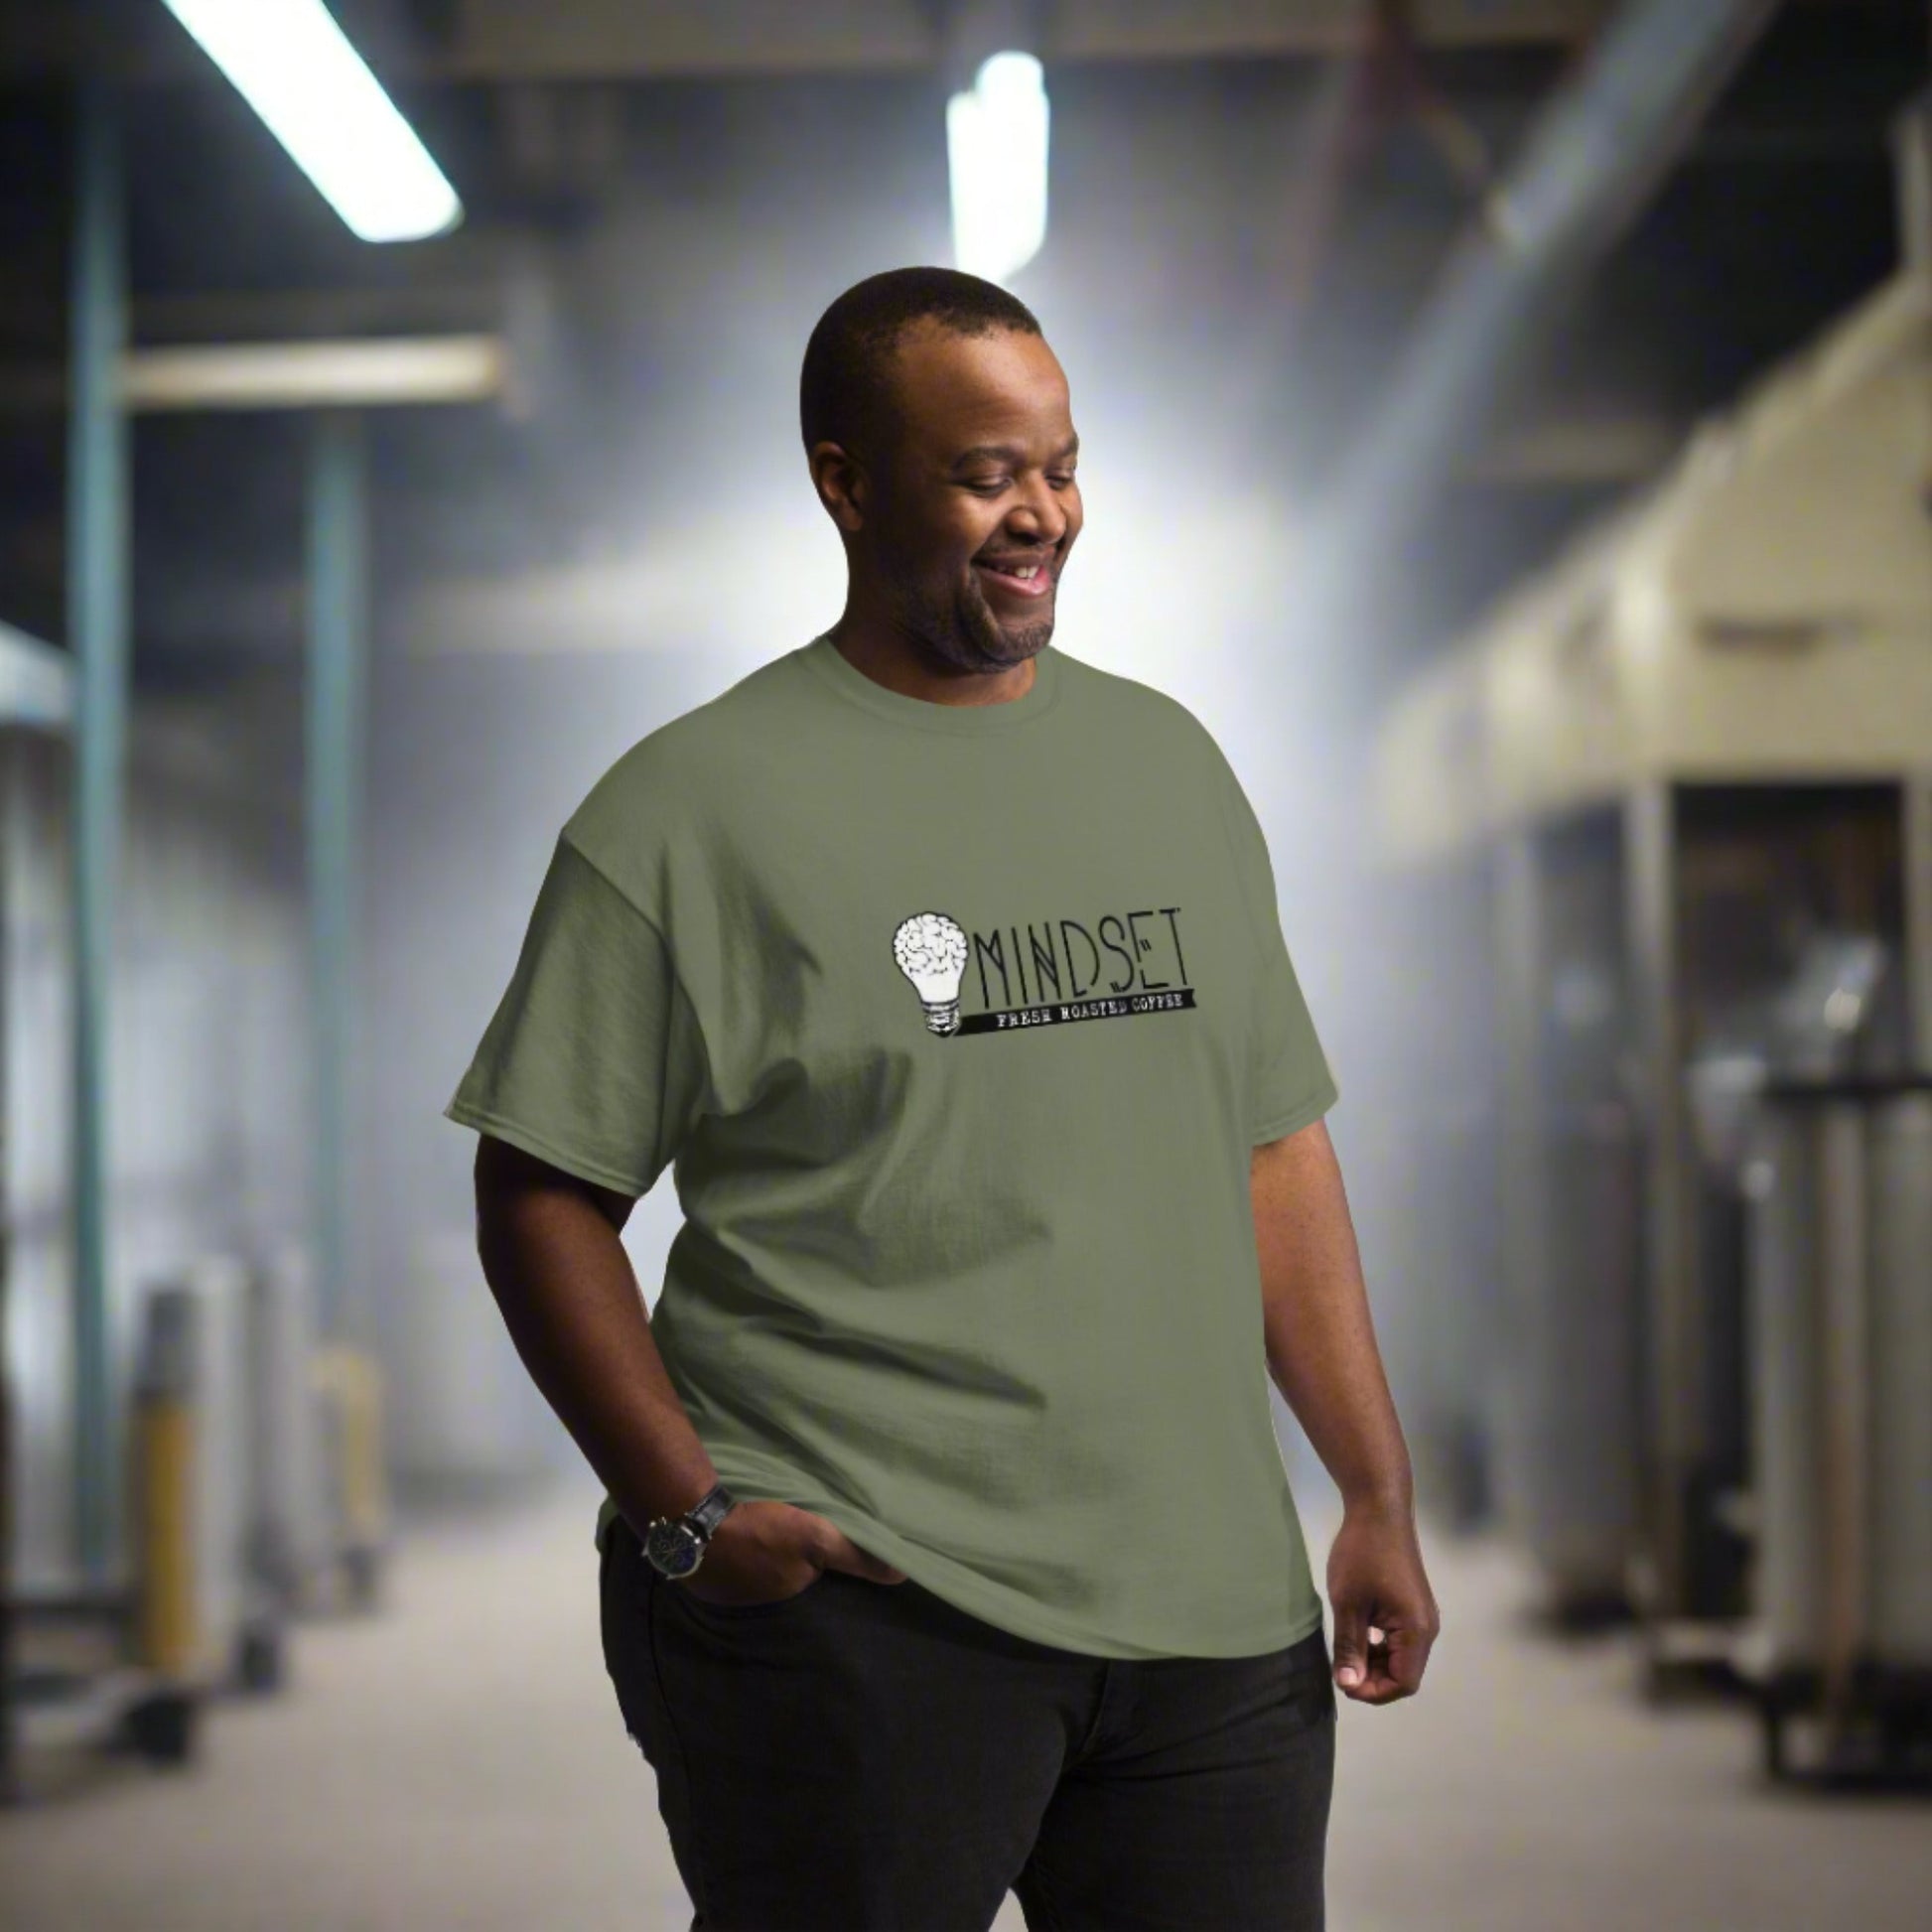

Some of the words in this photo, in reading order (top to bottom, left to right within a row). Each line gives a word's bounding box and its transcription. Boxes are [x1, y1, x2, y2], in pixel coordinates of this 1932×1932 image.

[973, 907, 1187, 1009] MINDSET
[996, 1008, 1052, 1028] FRESH
[1060, 999, 1128, 1021] ROASTED
[1131, 994, 1184, 1013] COFFEE
